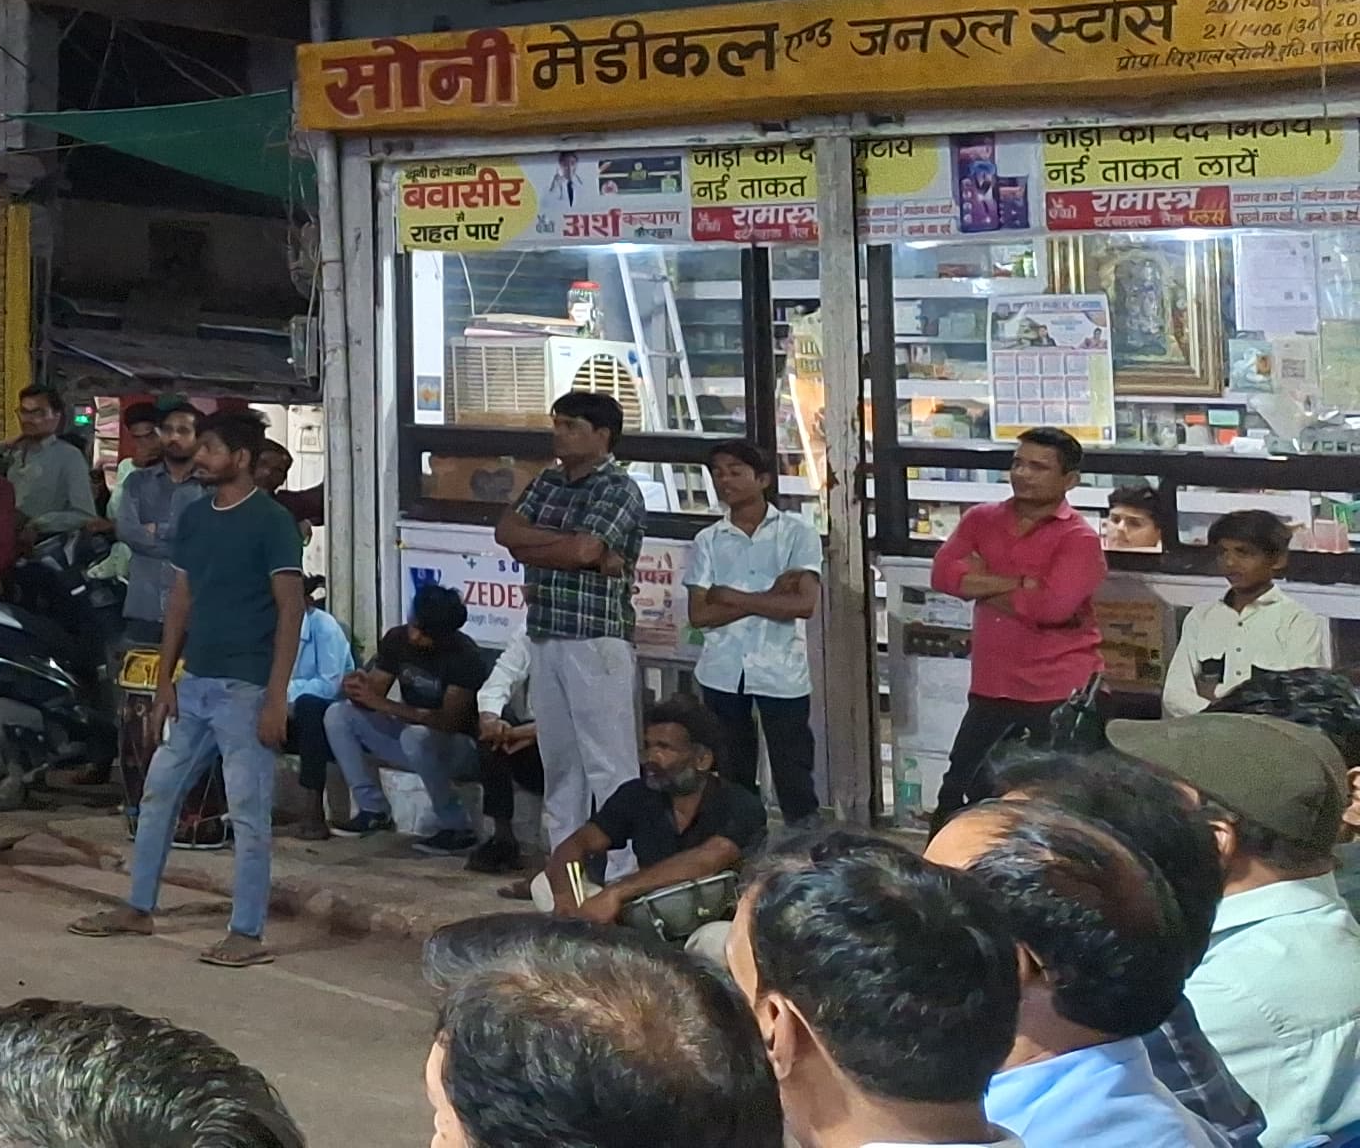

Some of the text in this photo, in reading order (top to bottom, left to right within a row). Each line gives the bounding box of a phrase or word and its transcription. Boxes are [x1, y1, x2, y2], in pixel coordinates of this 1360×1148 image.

[322, 28, 518, 116] सोनी
[527, 19, 780, 91] मेडीकल
[848, 9, 1019, 58] जनरल
[1045, 148, 1259, 185] नई ताकत लायें
[402, 167, 524, 209] बवासीर
[693, 174, 808, 201] नई ताकत
[1091, 187, 1201, 213] रामास्त्र
[563, 208, 623, 238] अर्श
[1188, 207, 1226, 227] प्लस
[410, 223, 459, 244] राहत
